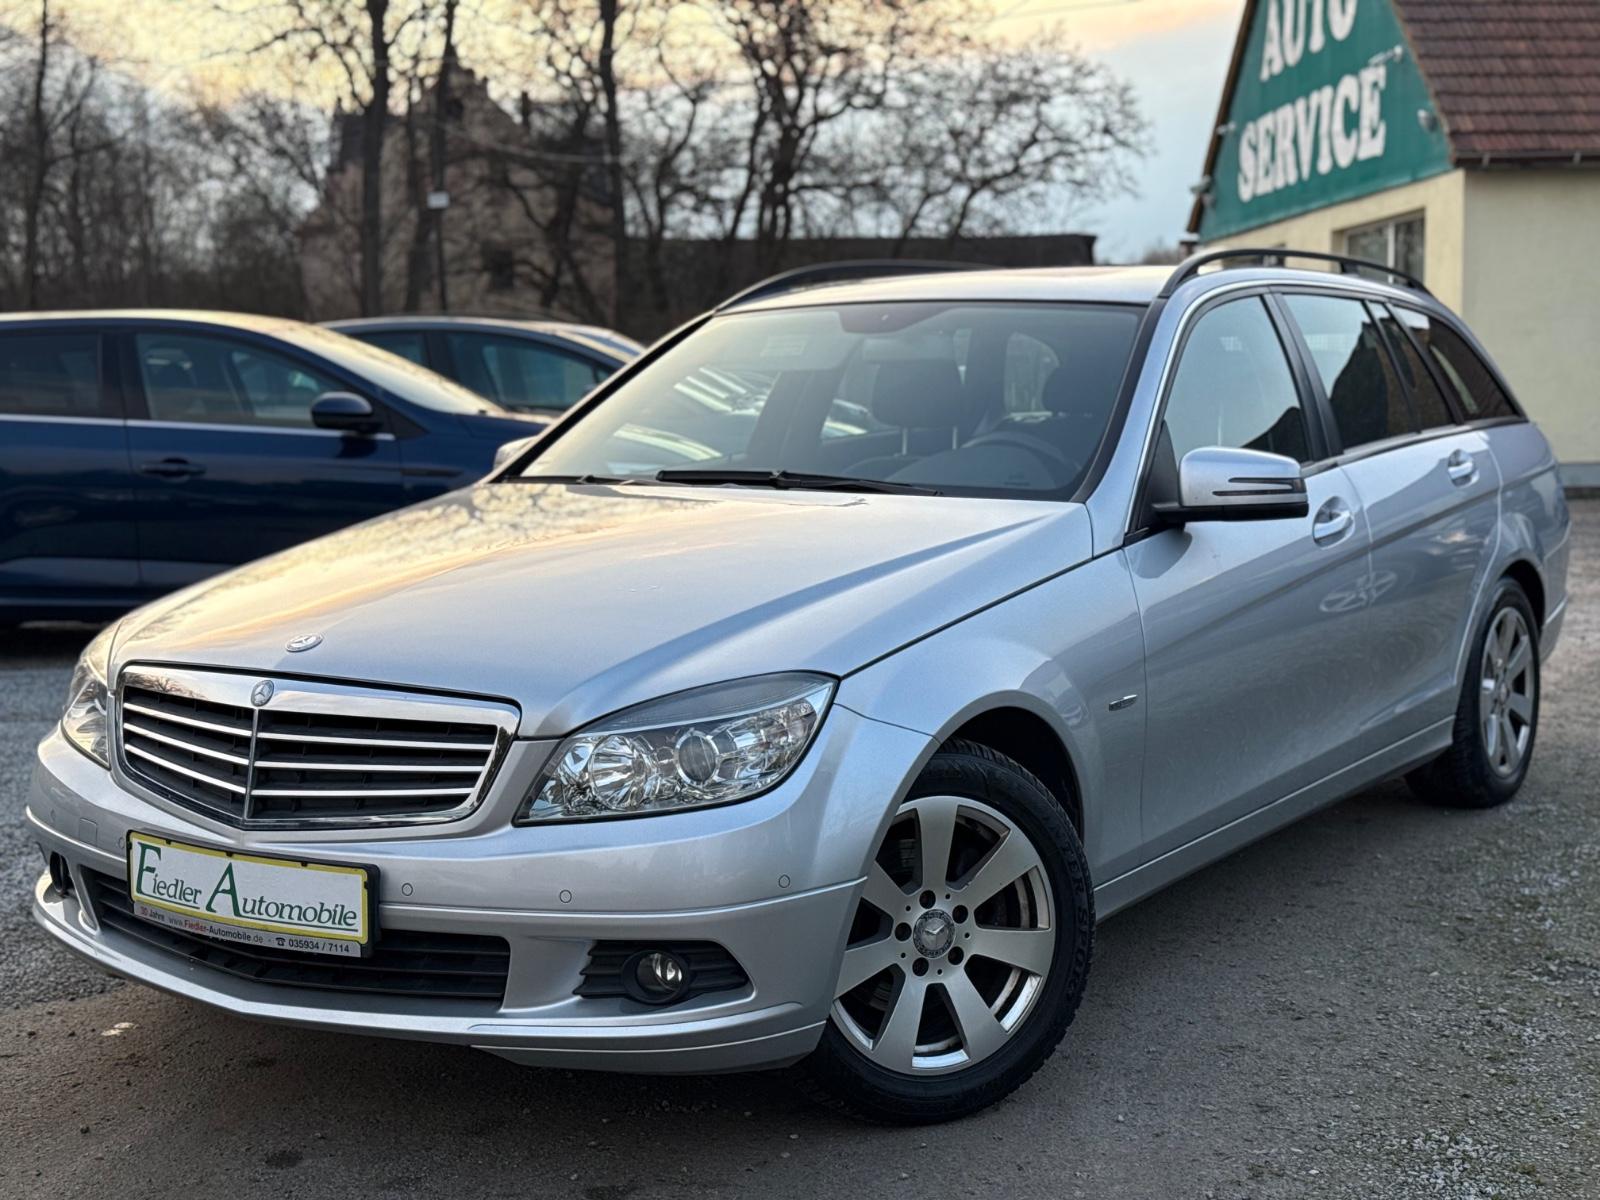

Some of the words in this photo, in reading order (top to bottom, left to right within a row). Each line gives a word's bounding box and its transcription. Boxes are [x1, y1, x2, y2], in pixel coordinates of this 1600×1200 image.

[1237, 65, 1386, 203] SERVICE
[135, 842, 202, 905] Fiedler
[205, 862, 358, 927] Automobile
[288, 938, 319, 950] 035934
[328, 942, 350, 953] 7114
